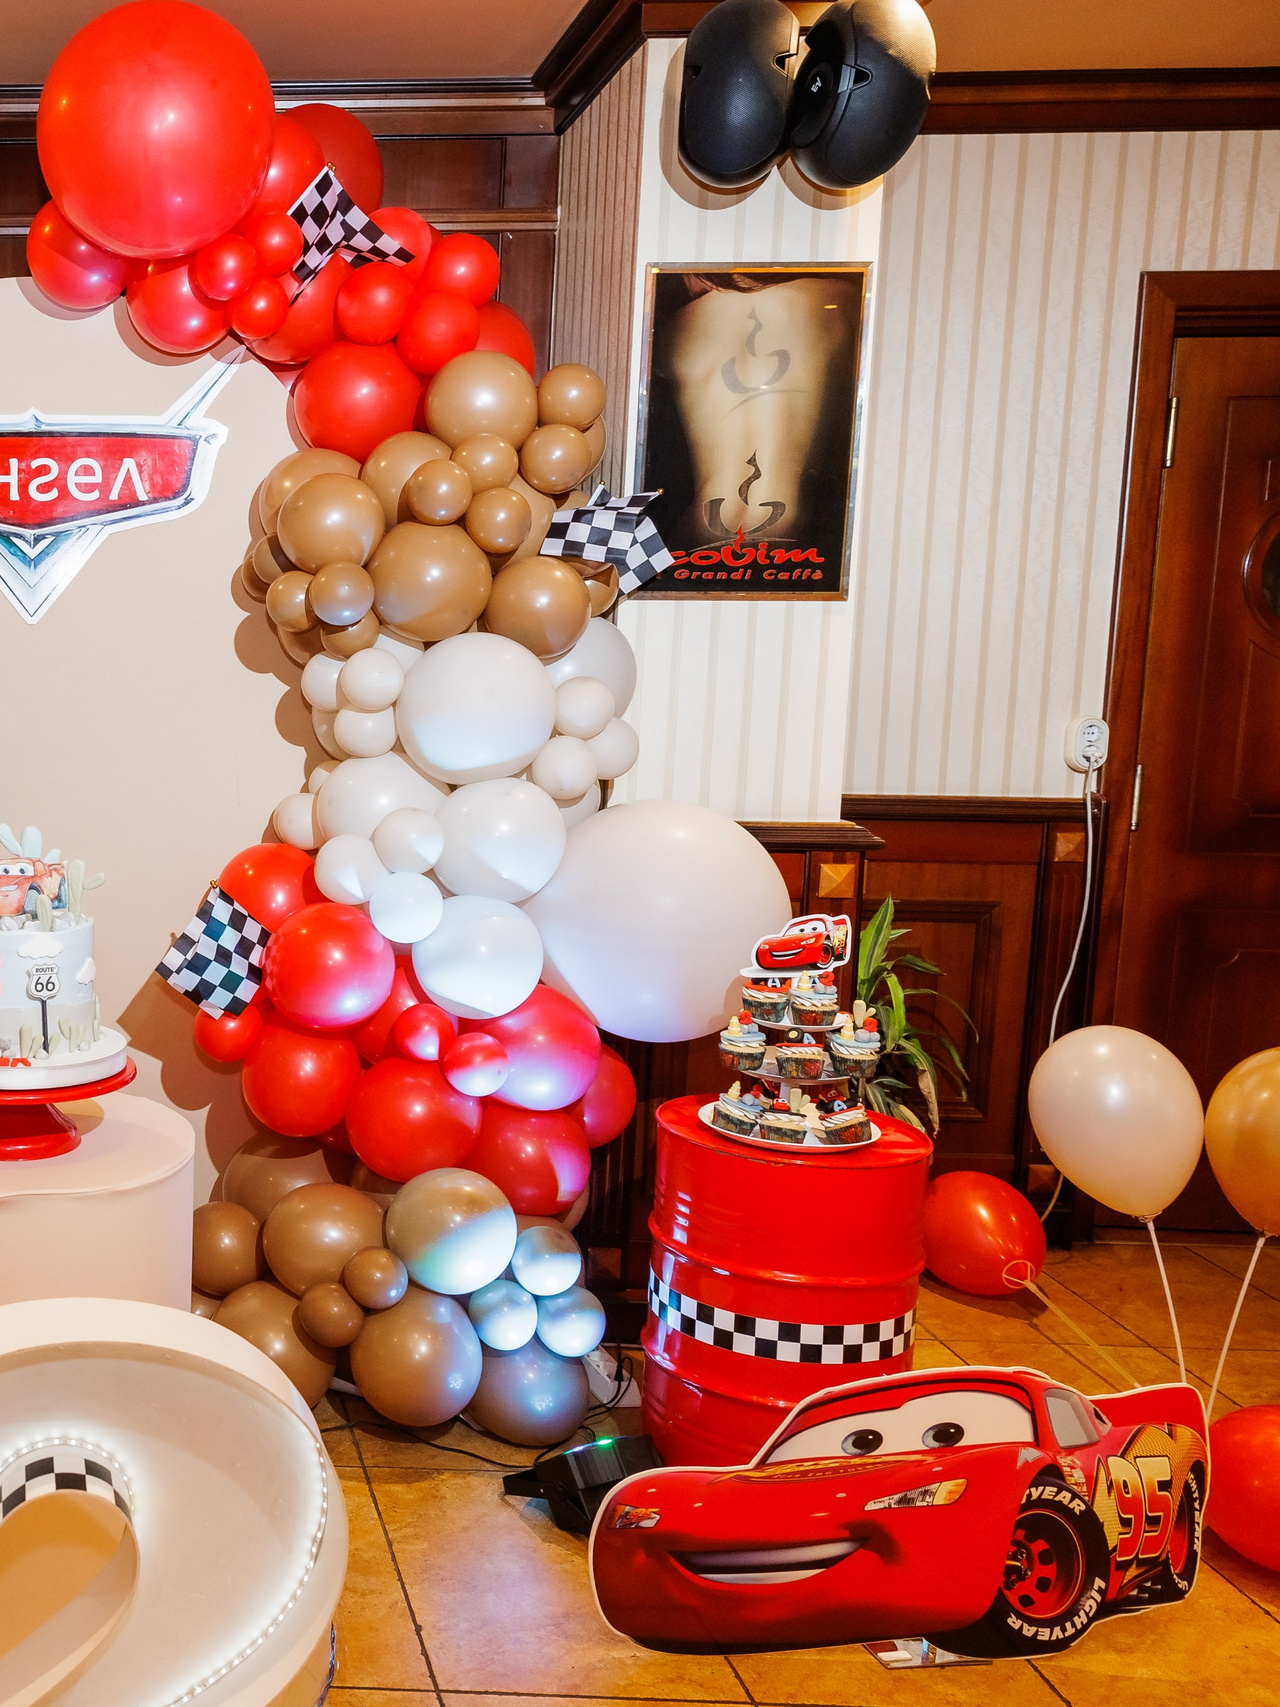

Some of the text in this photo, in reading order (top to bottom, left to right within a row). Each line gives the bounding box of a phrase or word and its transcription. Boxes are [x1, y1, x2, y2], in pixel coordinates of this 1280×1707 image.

[674, 568, 752, 580] Grandi
[763, 568, 823, 580] Caffè
[35, 966, 55, 974] ROUTE
[34, 975, 56, 993] 66
[1107, 1456, 1173, 1561] 95
[1006, 1576, 1106, 1641] LIGHTYEAR
